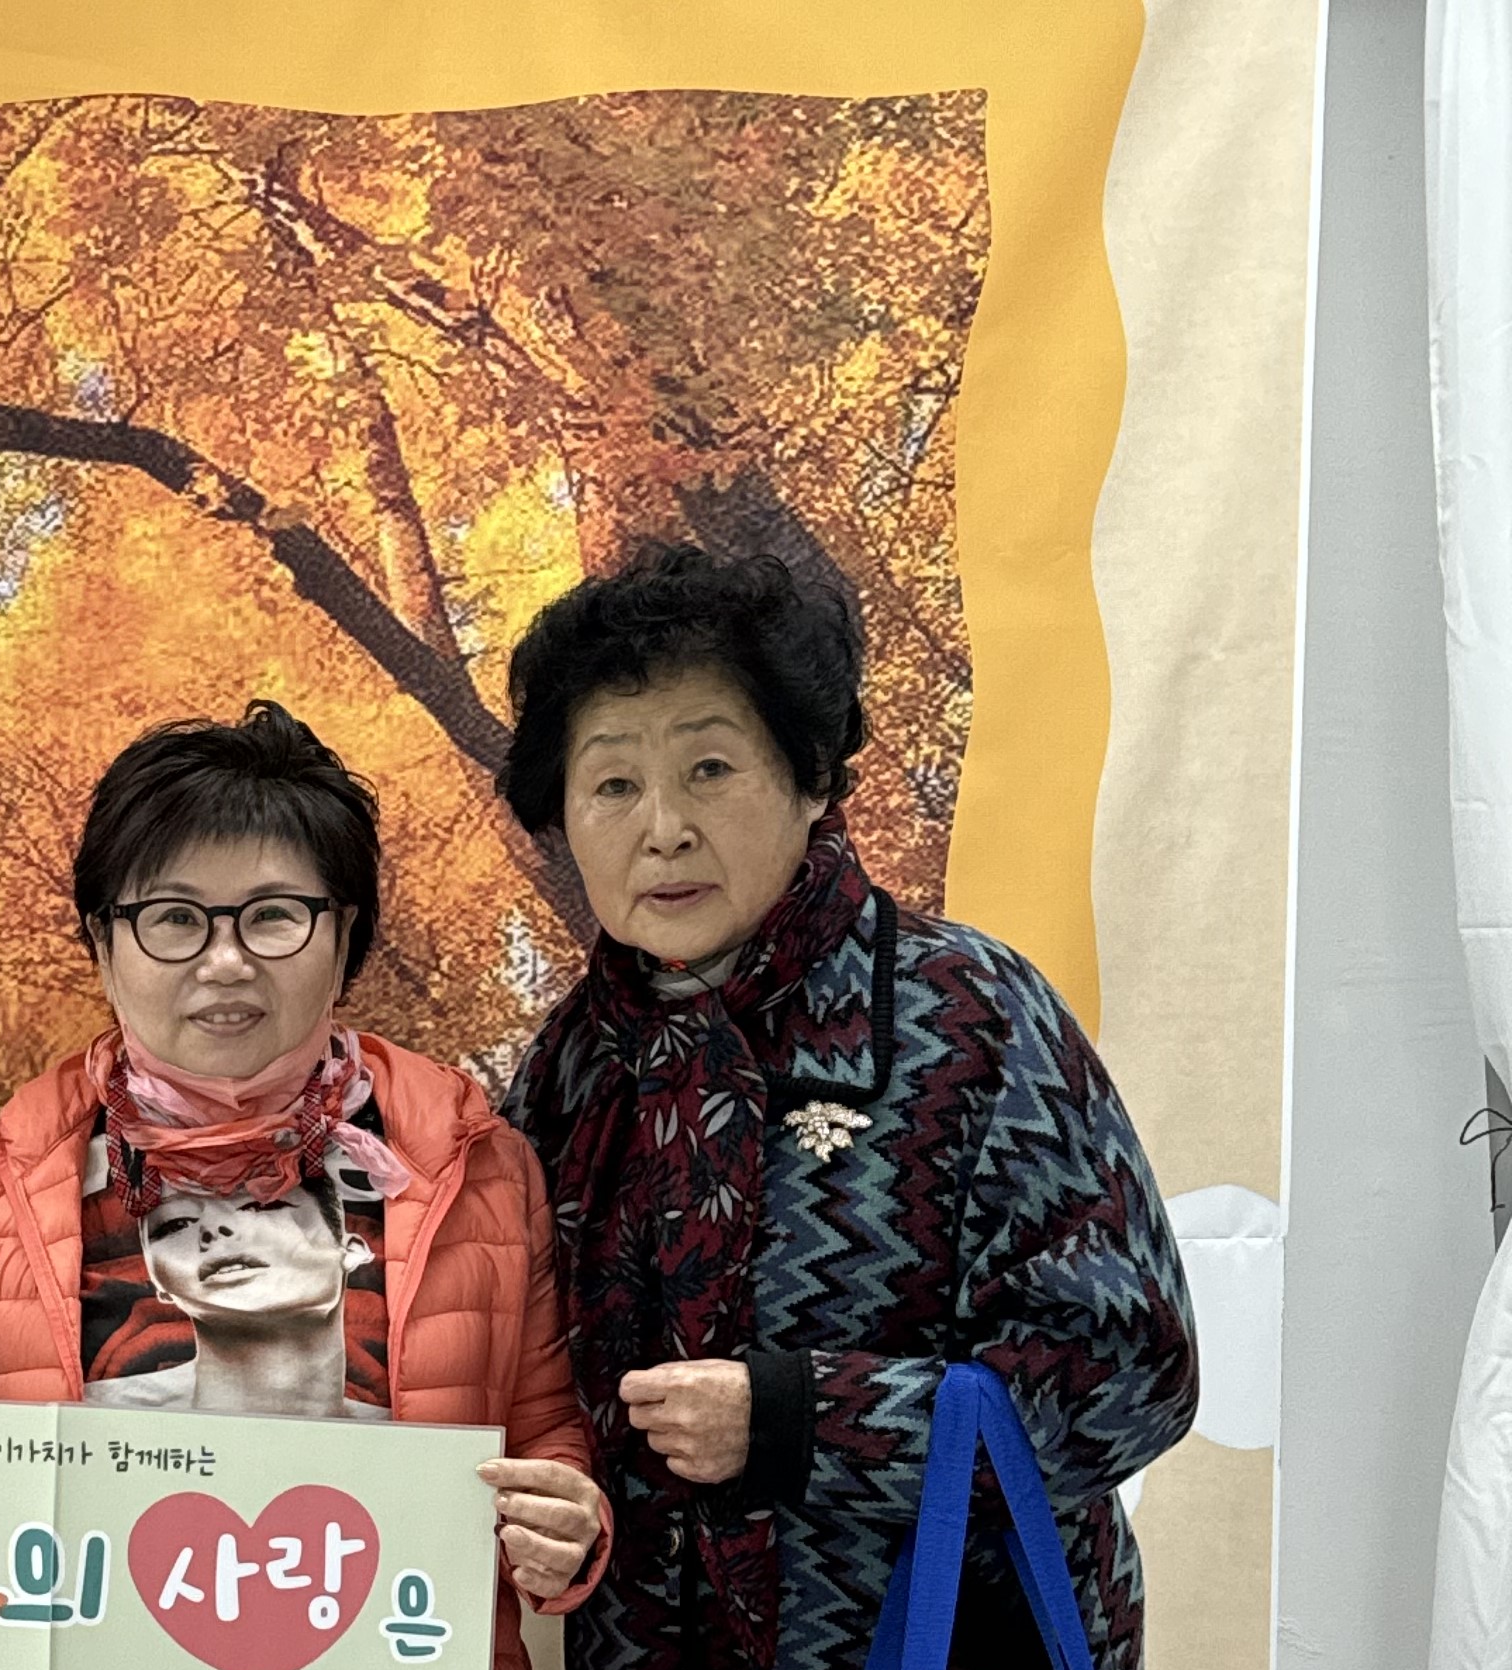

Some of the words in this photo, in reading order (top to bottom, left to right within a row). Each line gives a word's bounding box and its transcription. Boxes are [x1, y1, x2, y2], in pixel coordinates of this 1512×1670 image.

[107, 1440, 217, 1478] 함께하는
[158, 1521, 367, 1631] 사랑
[384, 1574, 447, 1658] 은
